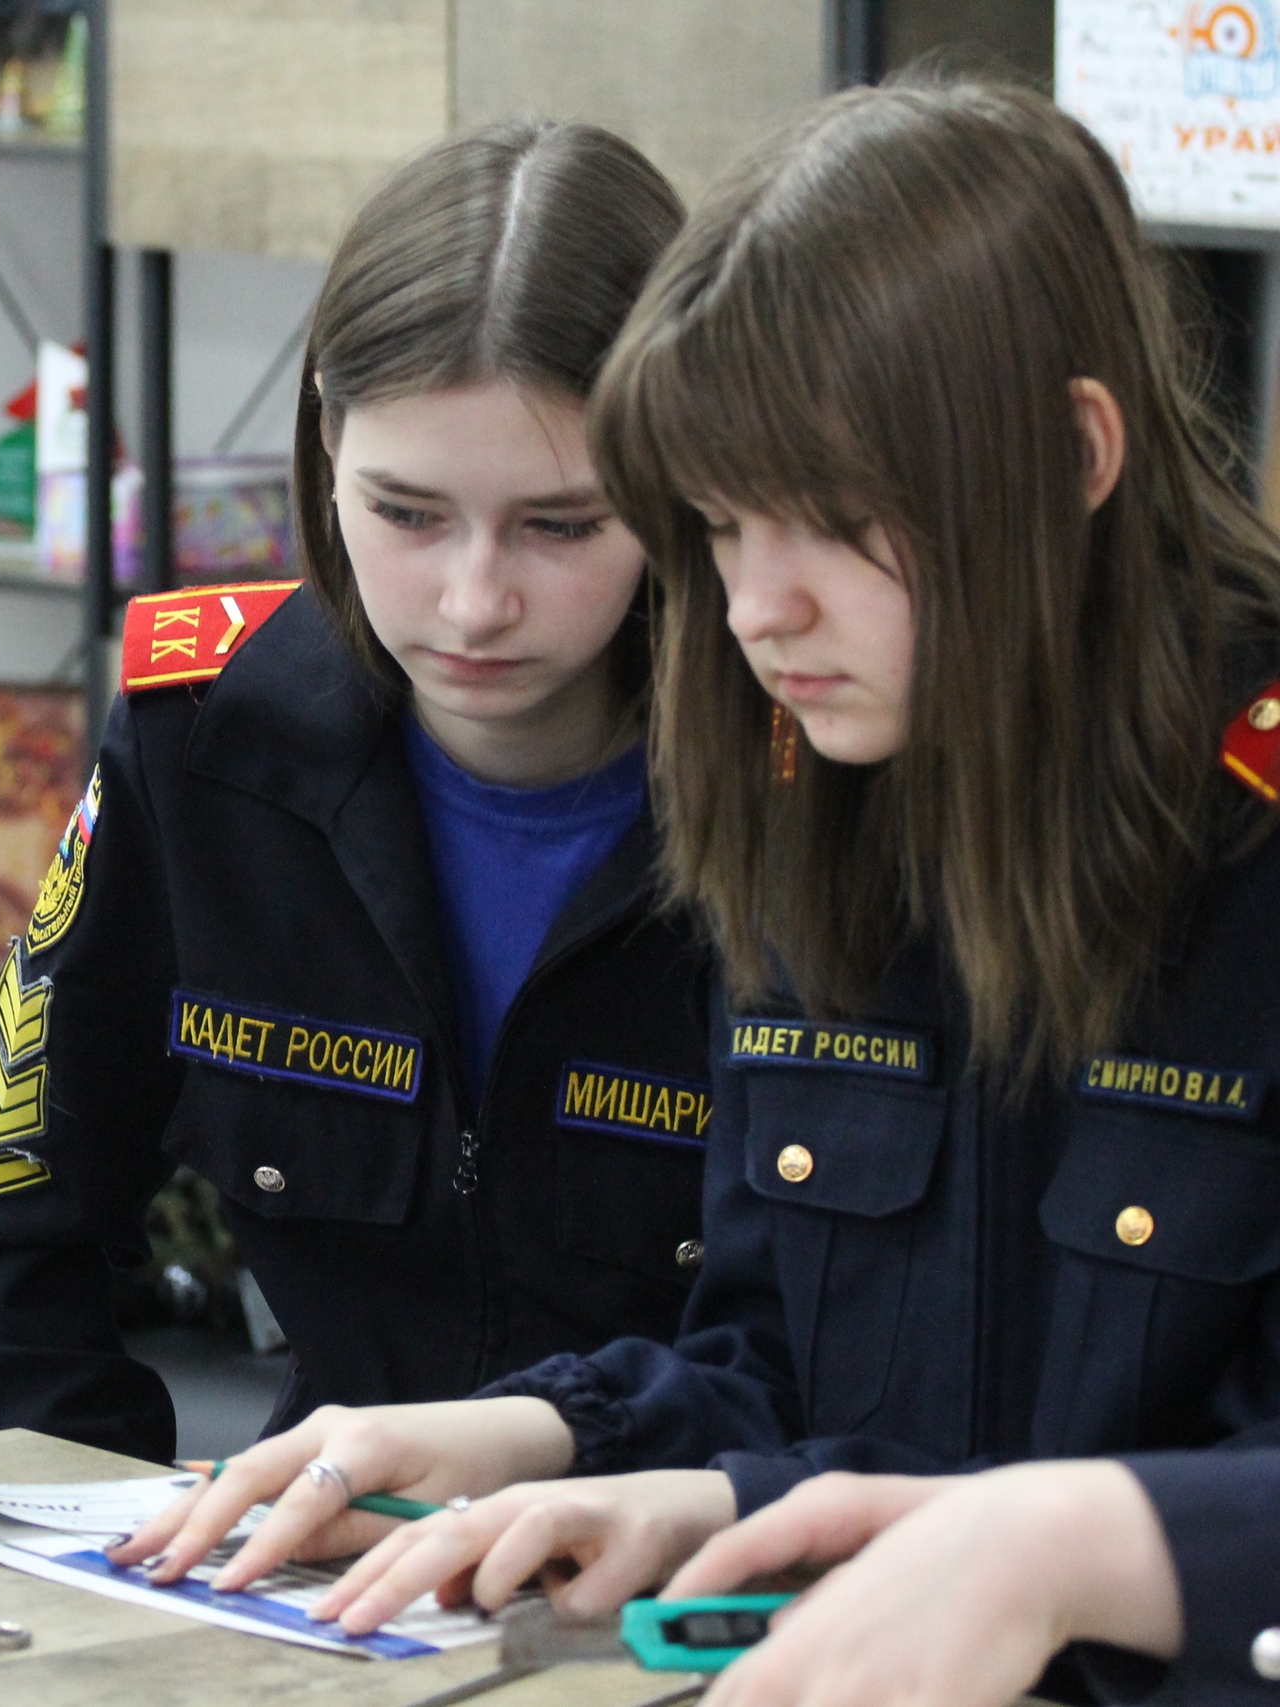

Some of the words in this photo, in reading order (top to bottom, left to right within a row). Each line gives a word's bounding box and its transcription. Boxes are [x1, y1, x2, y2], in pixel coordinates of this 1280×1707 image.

[180, 1001, 275, 1064] КАДЕТ
[285, 1026, 416, 1091] РОССИИ
[814, 1031, 918, 1070] РОССИИ
